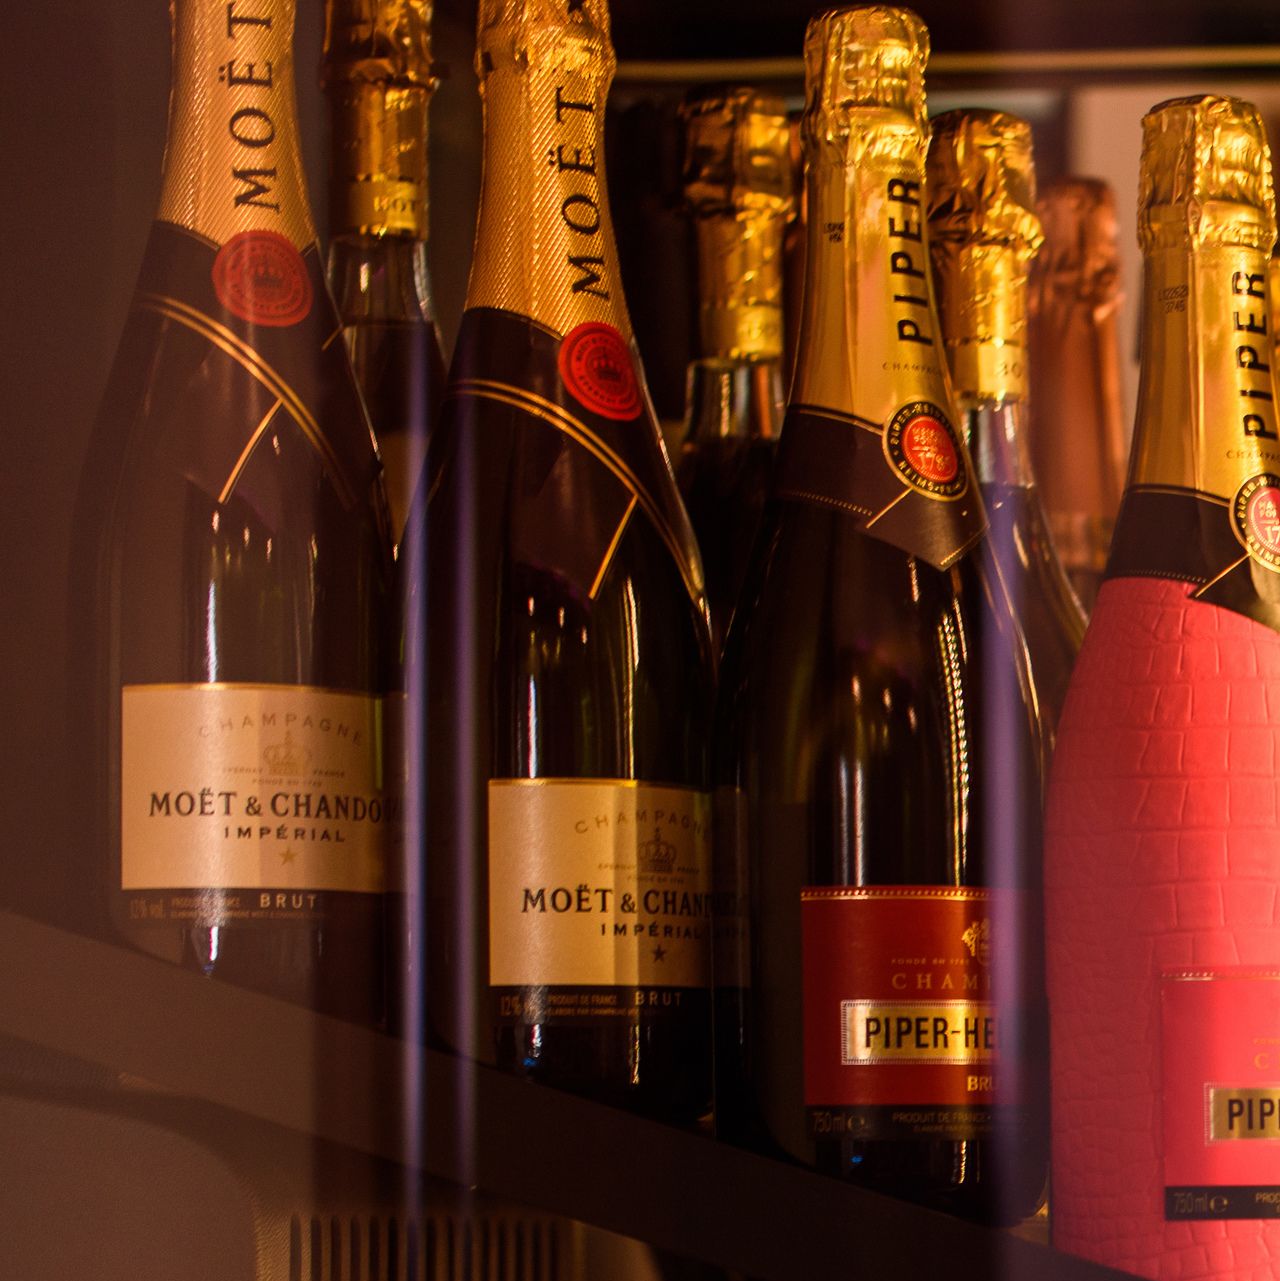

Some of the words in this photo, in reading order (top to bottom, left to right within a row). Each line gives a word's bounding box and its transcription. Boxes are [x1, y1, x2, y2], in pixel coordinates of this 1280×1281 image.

[218, 1, 281, 214] MOËT
[549, 86, 609, 300] MOËT
[887, 178, 933, 346] PIPER
[1232, 271, 1279, 442] PIPER
[199, 712, 362, 747] CHAMPAGNE
[149, 787, 237, 817] MOËT
[246, 799, 262, 817] &
[224, 824, 346, 843] IMPÉRIAL
[259, 893, 318, 910] BRUT
[521, 884, 613, 913] MOËT
[620, 893, 637, 914] &
[643, 889, 712, 919] CHAN
[600, 921, 702, 939] IMPÉRIAL
[634, 990, 684, 1008] BRUT
[865, 1017, 994, 1048] PIPER-HE
